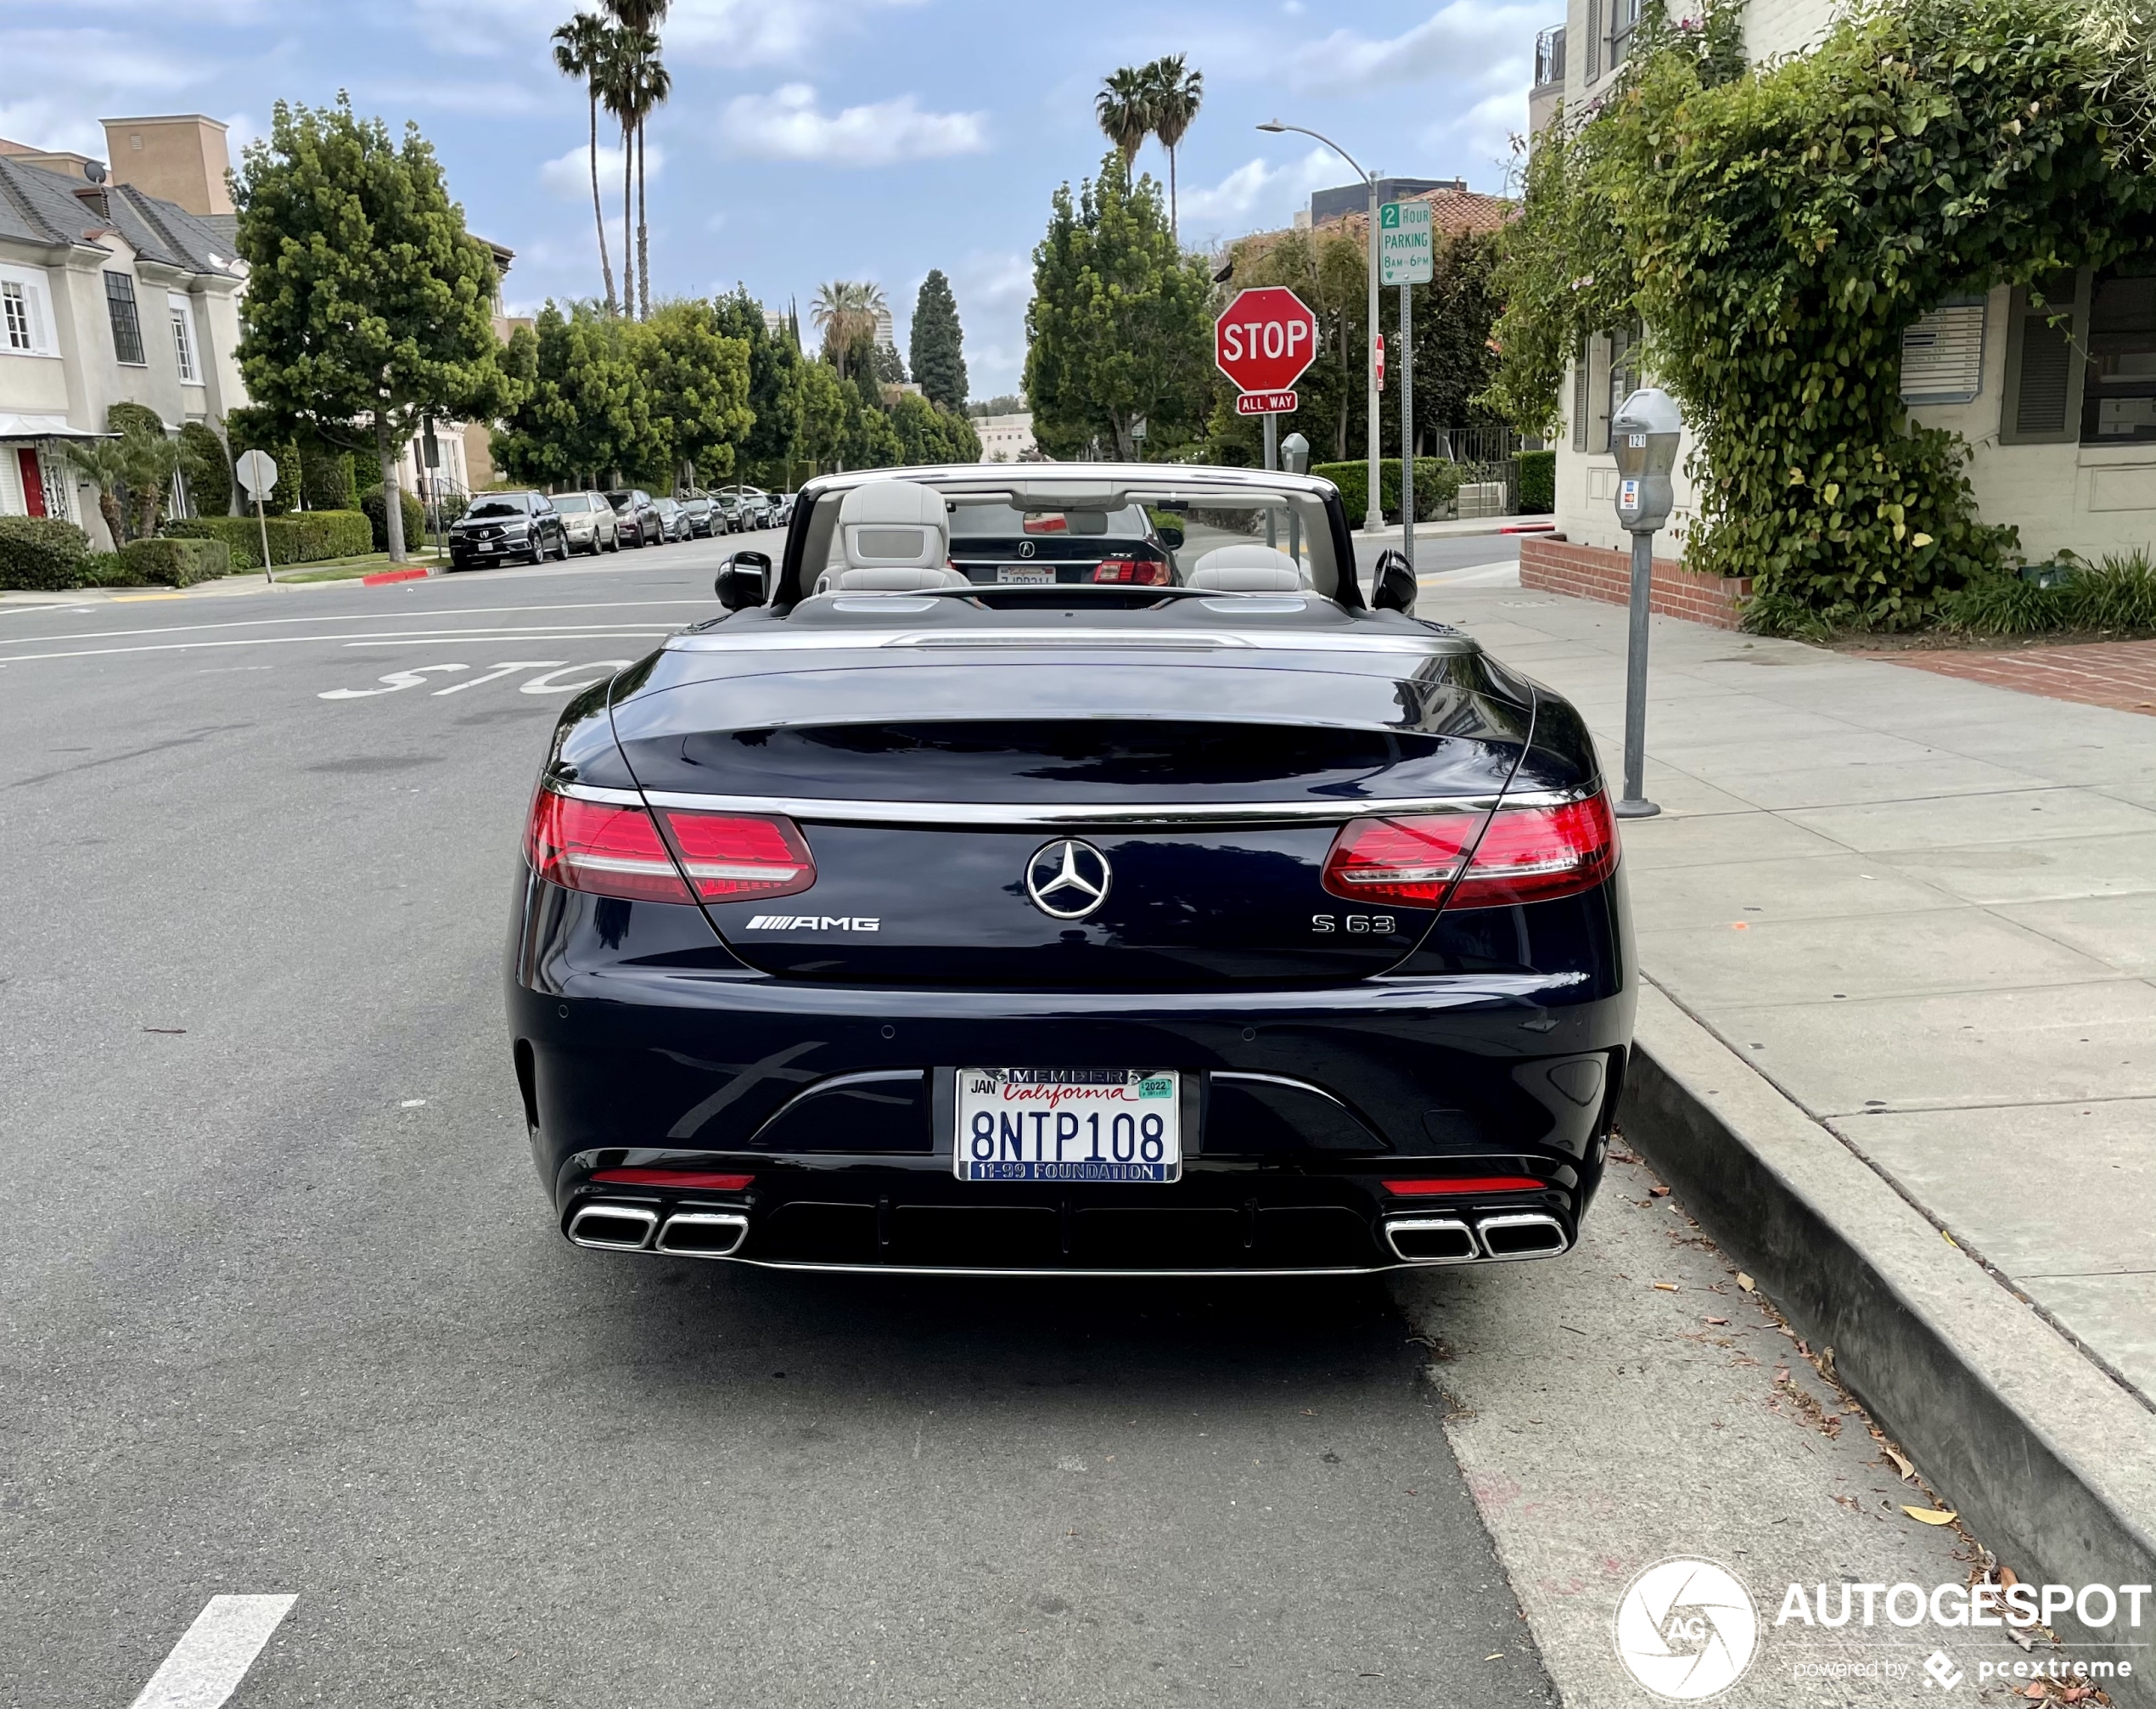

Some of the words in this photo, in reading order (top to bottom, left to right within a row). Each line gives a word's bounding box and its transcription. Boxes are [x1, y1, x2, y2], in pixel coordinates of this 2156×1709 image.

[1385, 207, 1395, 226] 2
[1403, 209, 1429, 224] HOUR
[1384, 232, 1428, 250] PARKING
[1384, 256, 1403, 268] 8AM
[1410, 254, 1429, 267] 6PM
[1223, 320, 1308, 362] STOP
[1242, 397, 1264, 412] ALL
[1270, 396, 1293, 409] WAY
[1631, 435, 1645, 447] 121
[317, 660, 635, 700] STO
[789, 916, 880, 931] AMG
[1312, 914, 1335, 933] S
[1346, 915, 1395, 934] 63
[1013, 1070, 1123, 1083] MEMBER
[971, 1079, 997, 1094] JAN
[1003, 1083, 1140, 1109] California
[1145, 1081, 1166, 1091] 2022
[971, 1110, 1164, 1162] 8NTP108
[979, 1163, 1026, 1178] 11-99
